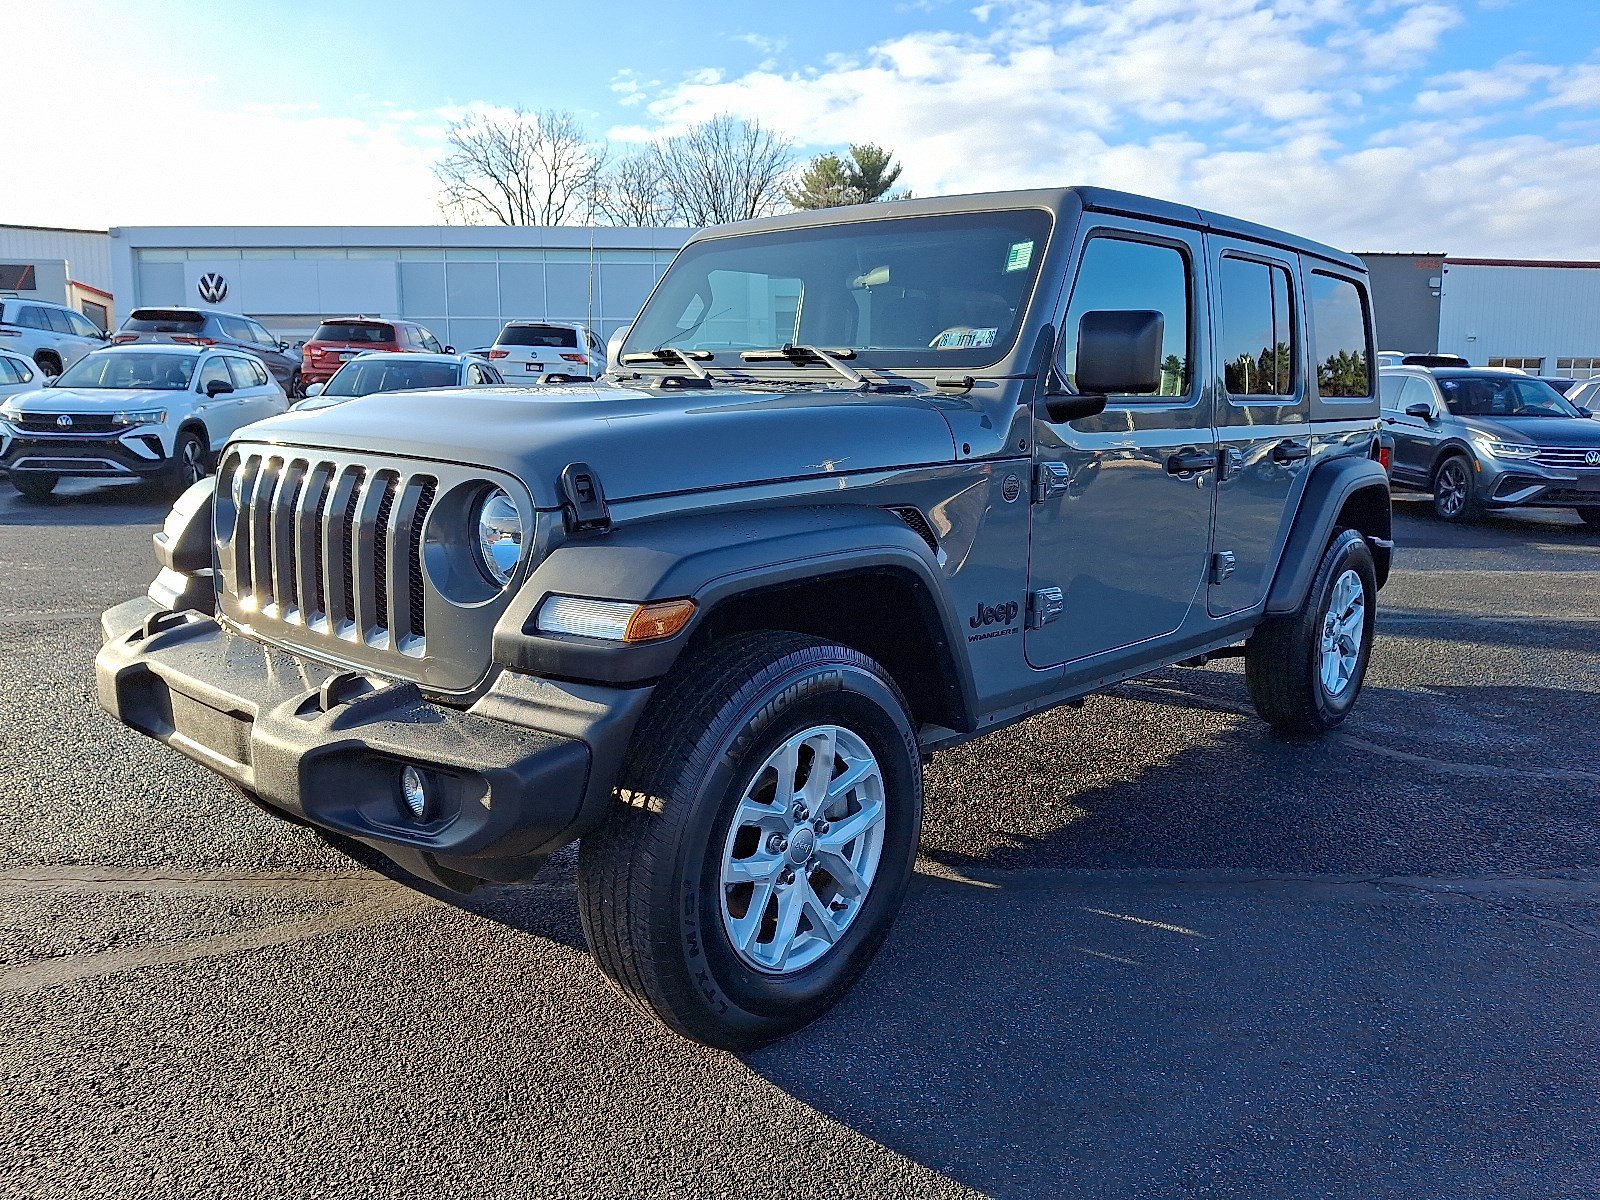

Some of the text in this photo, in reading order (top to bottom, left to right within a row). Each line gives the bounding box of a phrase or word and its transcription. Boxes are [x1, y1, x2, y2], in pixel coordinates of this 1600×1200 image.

[197, 272, 229, 304] VW
[970, 601, 1018, 628] Jeep
[968, 629, 1011, 642] WRANGLER
[749, 671, 838, 734] MICHELIN
